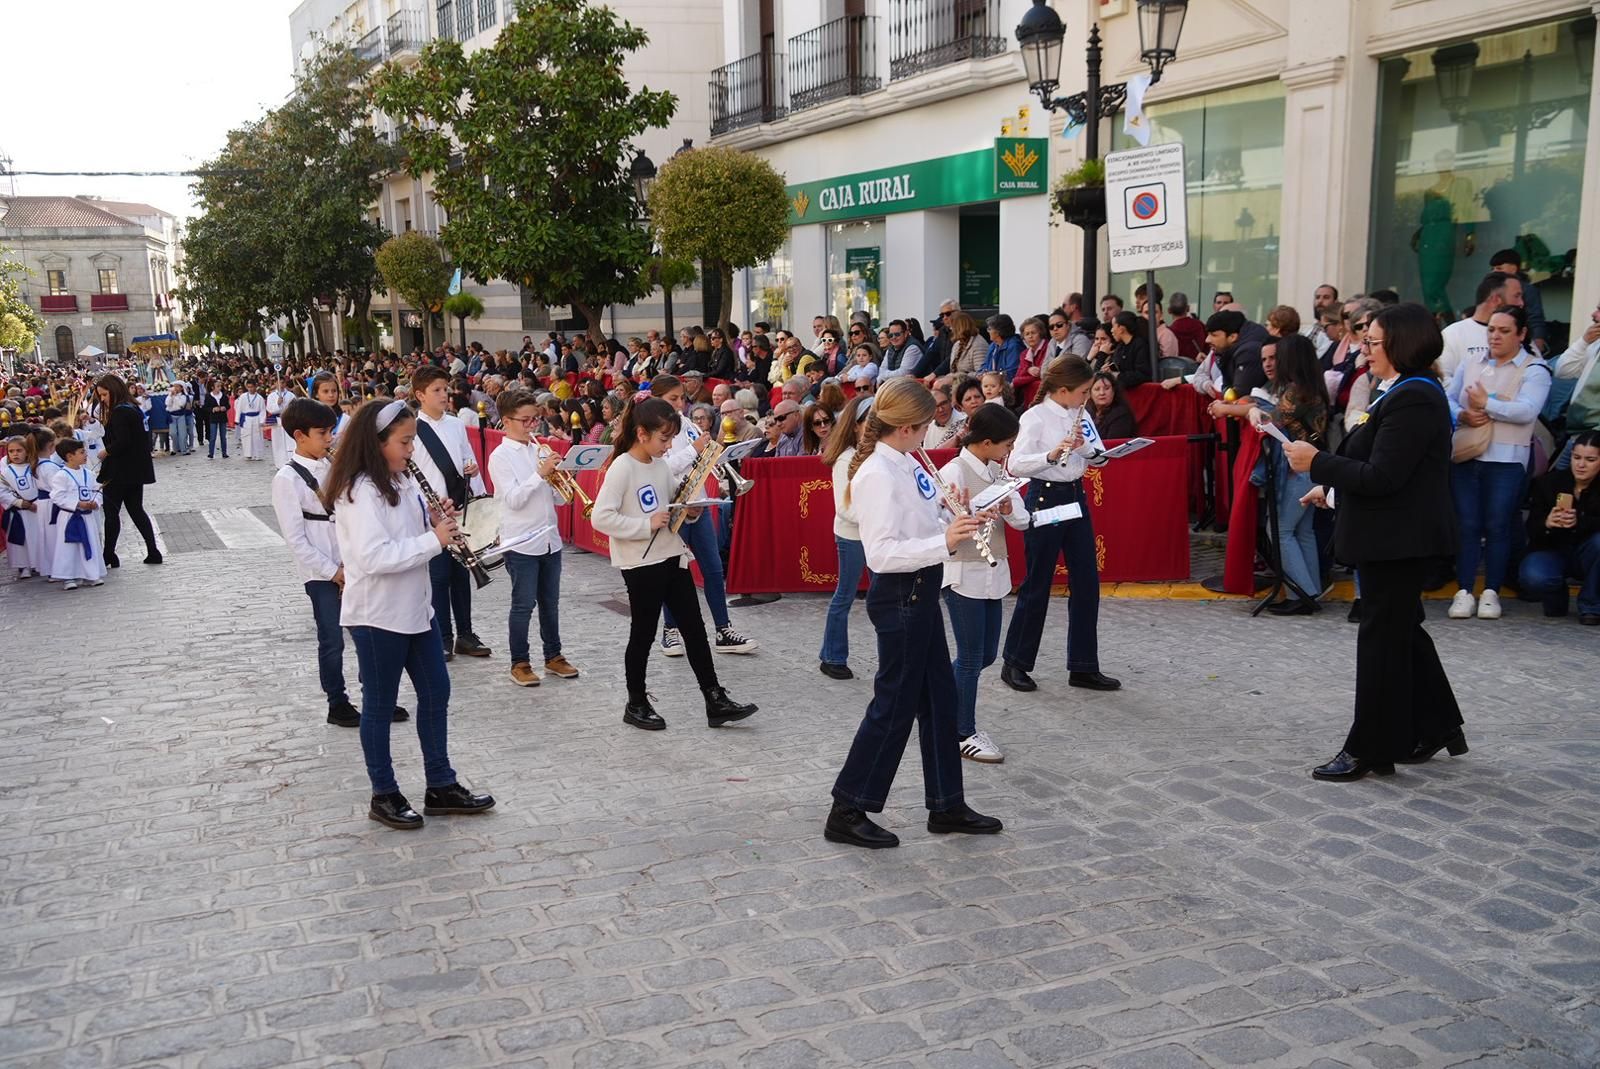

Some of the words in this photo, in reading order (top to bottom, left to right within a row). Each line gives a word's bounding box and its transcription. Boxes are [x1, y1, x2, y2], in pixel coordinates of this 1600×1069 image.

[1155, 147, 1180, 156] LIMITADO
[819, 184, 855, 211] CAJA
[858, 174, 915, 205] RURAL
[999, 181, 1016, 189] CAJA
[1017, 181, 1039, 189] RURAL
[1112, 249, 1121, 258] DE
[1161, 240, 1184, 252] HORAS
[917, 472, 931, 491] G
[641, 489, 655, 506] G
